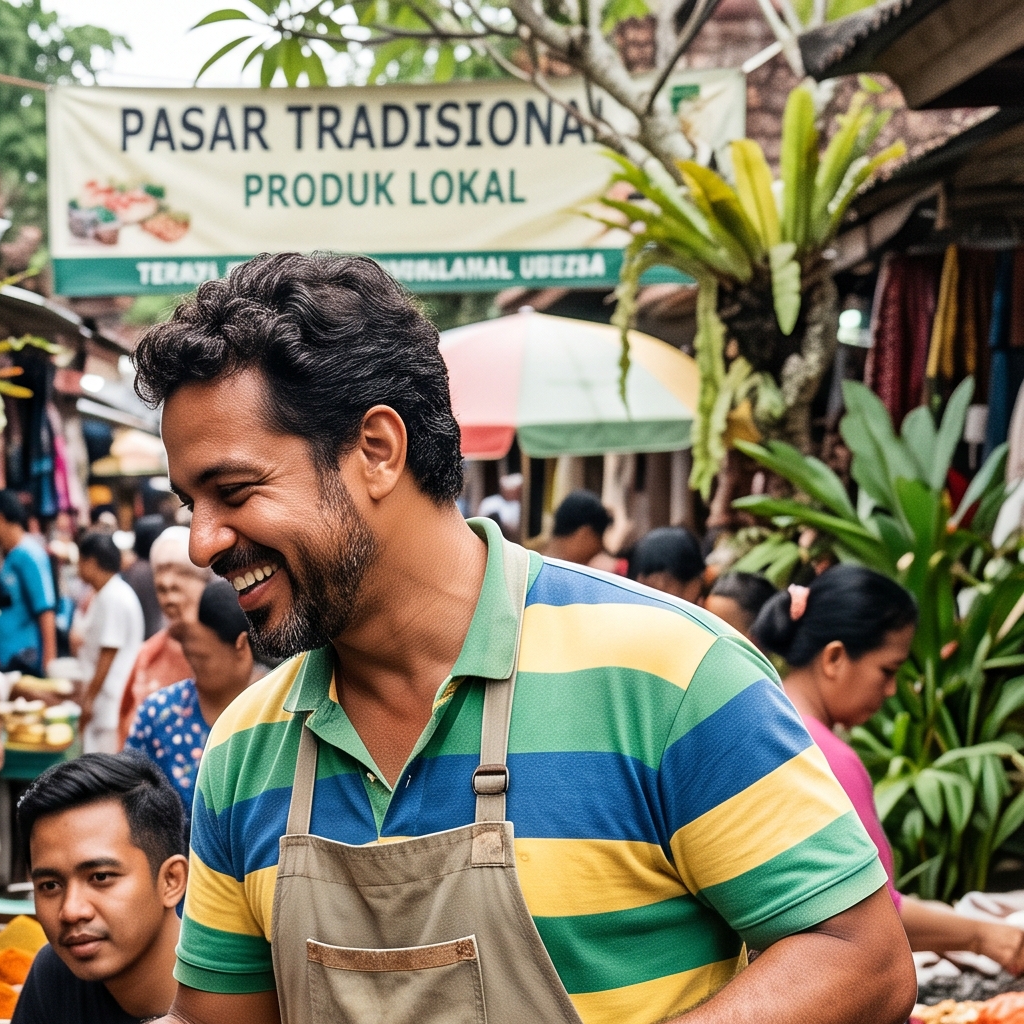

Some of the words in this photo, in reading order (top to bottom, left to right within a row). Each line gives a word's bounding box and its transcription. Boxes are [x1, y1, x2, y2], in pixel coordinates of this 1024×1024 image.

[120, 104, 270, 151] PASAR
[244, 171, 395, 208] PRODUK
[410, 168, 526, 206] LOKAL
